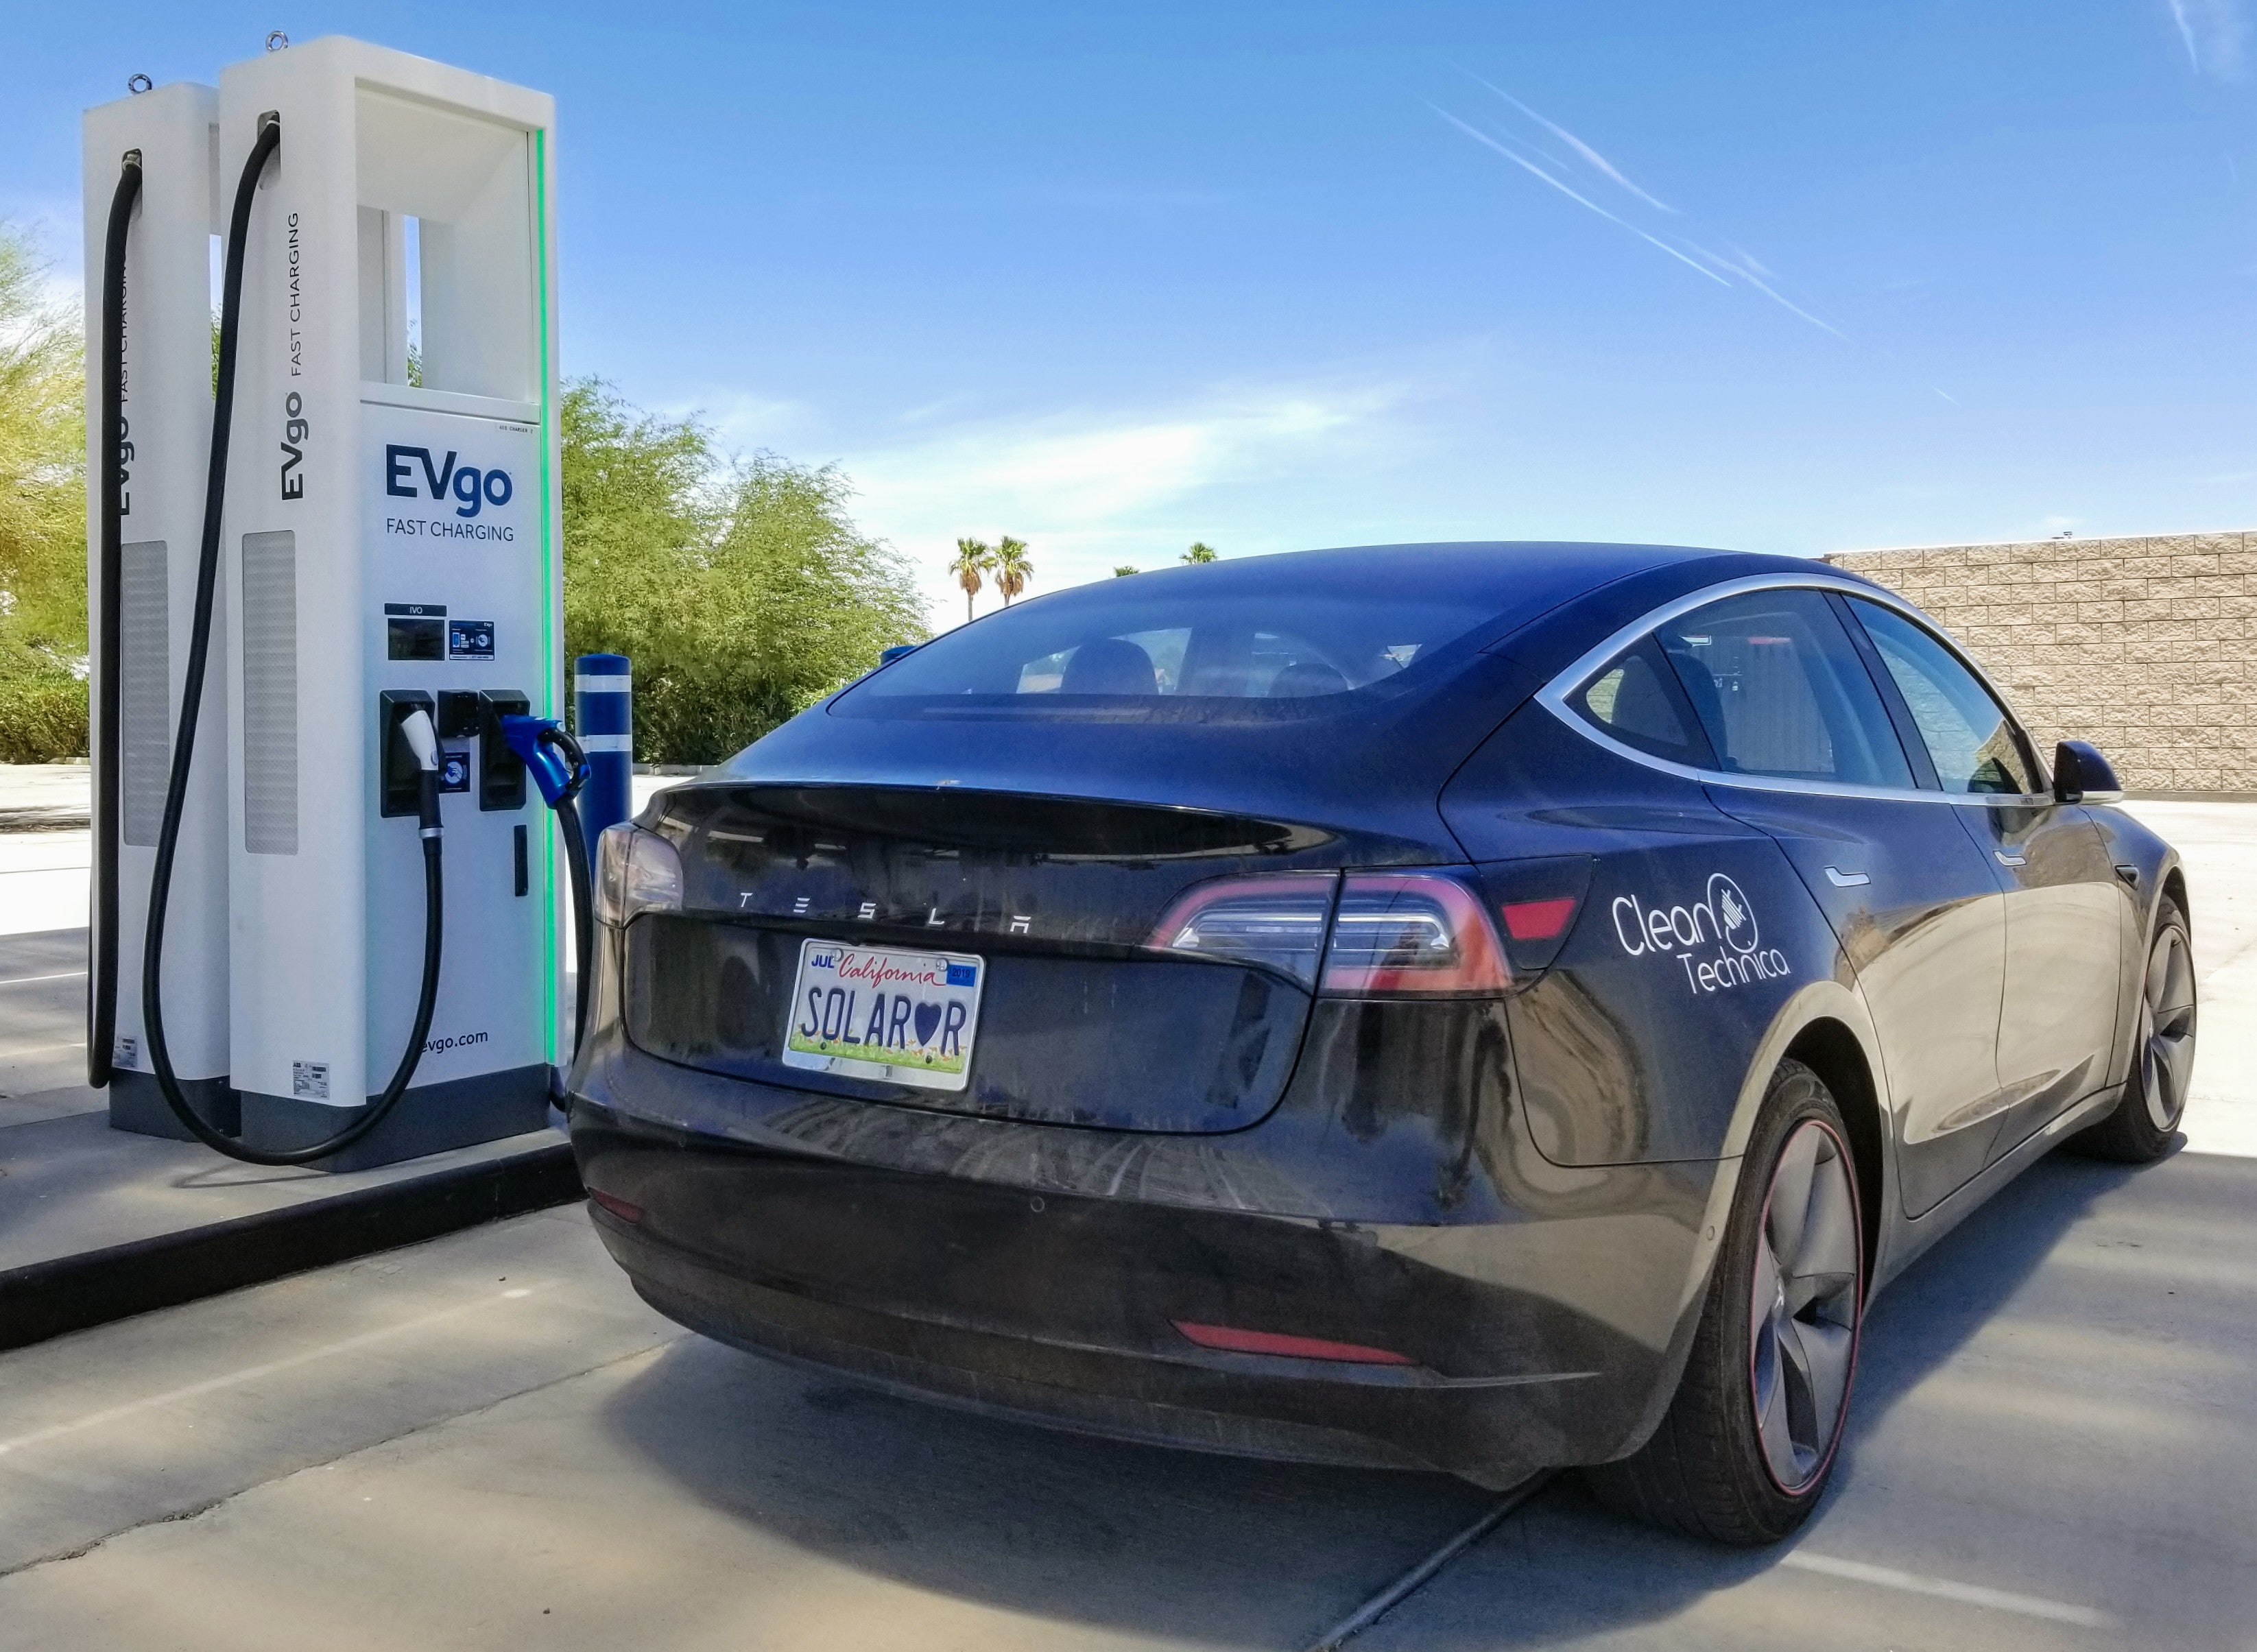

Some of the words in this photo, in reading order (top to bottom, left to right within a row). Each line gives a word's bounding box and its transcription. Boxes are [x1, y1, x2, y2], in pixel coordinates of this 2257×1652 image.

[288, 213, 300, 322] CHARGING
[290, 328, 302, 376] FAST
[280, 391, 309, 501] EVgo
[386, 444, 513, 518] EVgo
[386, 518, 427, 536] FAST
[430, 521, 514, 542] CHARGING
[740, 891, 1032, 934] TESLA
[1612, 894, 1722, 956] Clean
[811, 954, 835, 968] JUL
[839, 953, 946, 988] California
[951, 968, 970, 978] 2019
[1676, 946, 1791, 994] Technica
